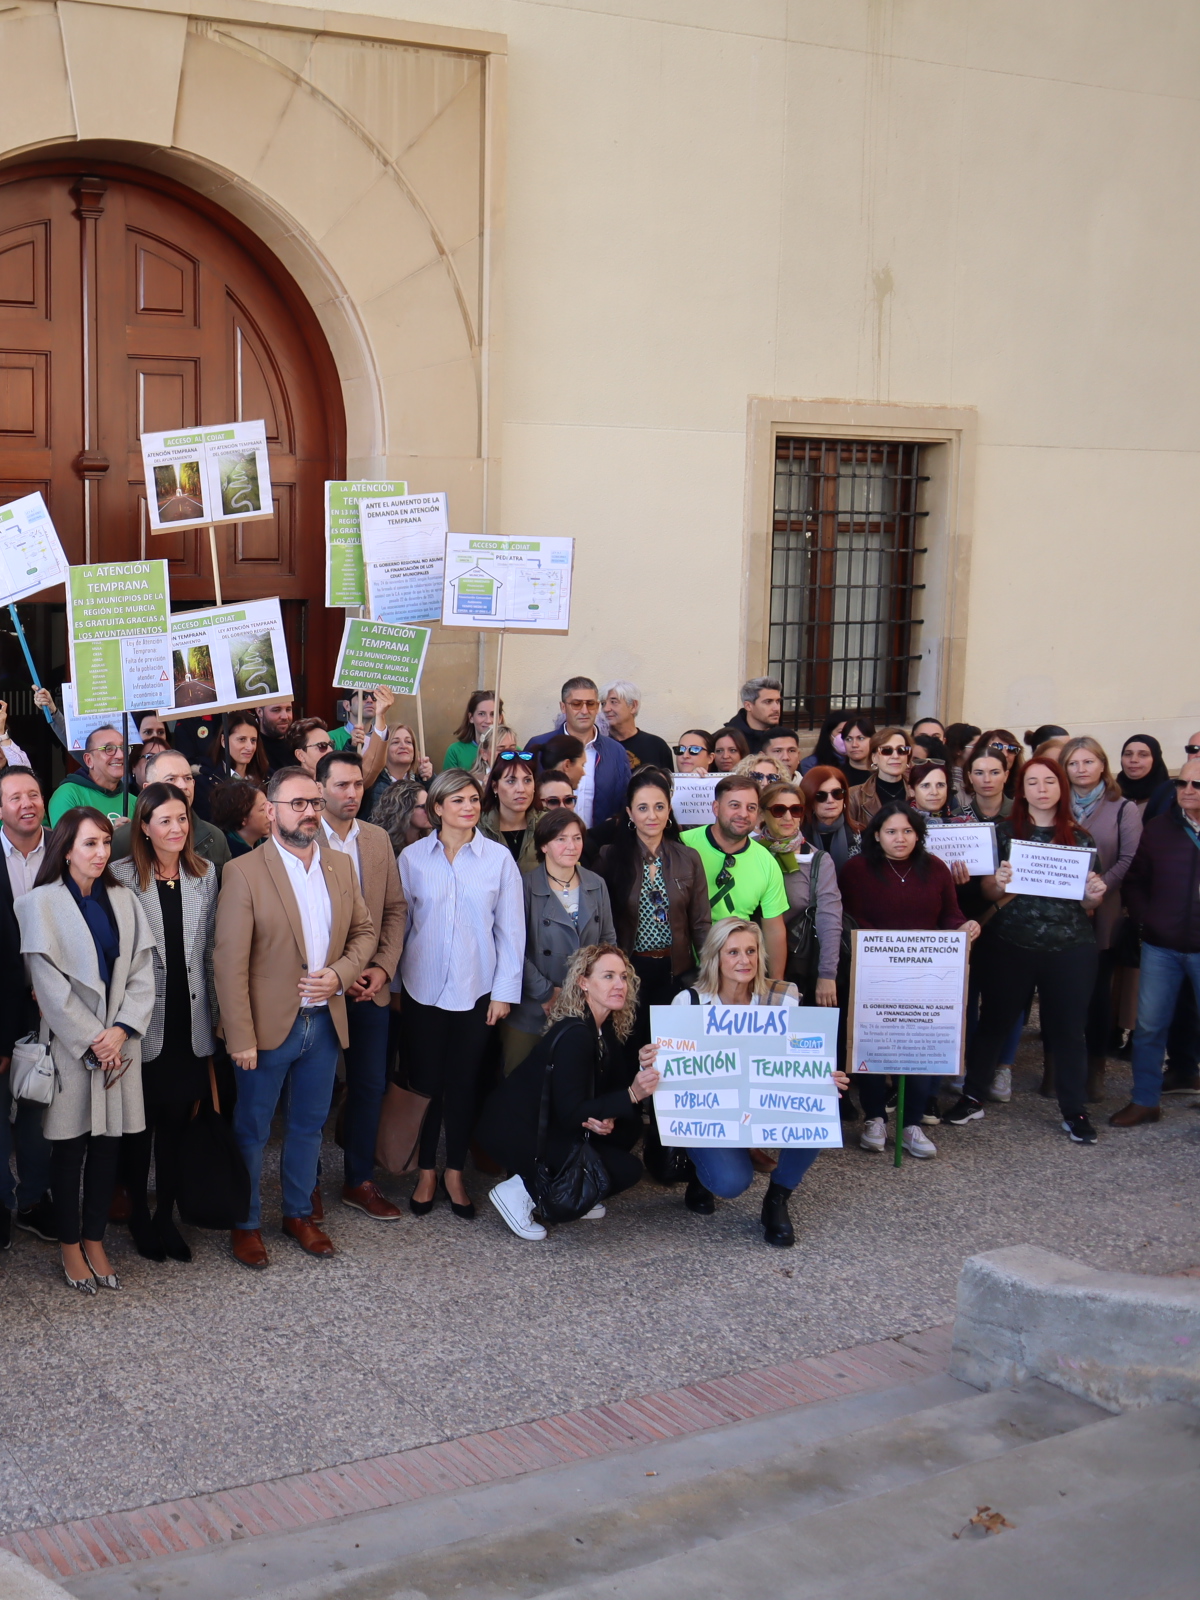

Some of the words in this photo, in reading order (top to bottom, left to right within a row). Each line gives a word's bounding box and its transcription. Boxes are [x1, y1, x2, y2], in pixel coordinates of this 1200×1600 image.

[351, 483, 394, 492] ATENCIÓN
[391, 498, 421, 507] AUMENTO
[367, 510, 399, 518] DEMANDA
[410, 505, 439, 514] ATENCIÓN
[388, 517, 422, 525] TEMPRANA
[97, 562, 150, 576] ATENCIÓN
[87, 580, 148, 592] TEMPRANA
[97, 595, 141, 604] MUNICIPIOS
[84, 607, 111, 616] REGIÓN
[126, 605, 155, 613] MURCIA
[86, 618, 124, 627] GRATUITA
[127, 616, 158, 624] GRACIAS
[173, 621, 199, 630] ACCESO
[216, 615, 235, 624] CDIAT
[227, 624, 250, 632] ATENCIÓN
[251, 620, 277, 628] TEMPRANA
[94, 626, 162, 638] AYUNTAMIENTOS
[178, 631, 206, 639] TEMPRANA
[371, 625, 416, 638] ATENCIÓN
[361, 638, 410, 652] TEMPRANA
[364, 652, 401, 661] MUNICIPIOS
[351, 660, 374, 668] REGIÓN
[350, 670, 381, 679] GRATUITA
[383, 674, 408, 682] GRACIAS
[1031, 855, 1079, 864] AYUNTAMIENTOS
[706, 1005, 788, 1035] ÁGUILAS
[657, 1037, 672, 1048] POR
[676, 1040, 695, 1051] UNA
[800, 1040, 822, 1049] CDIAT
[663, 1051, 736, 1078] ATENCIÓN
[752, 1059, 832, 1078] TEMPRANA
[674, 1091, 720, 1109] PÚBLICA
[760, 1094, 826, 1112] UNIVERSAL
[670, 1120, 726, 1137] GRATUITA
[742, 1113, 750, 1124] Y
[762, 1128, 777, 1141] DE
[782, 1126, 829, 1140] CALIDAD
